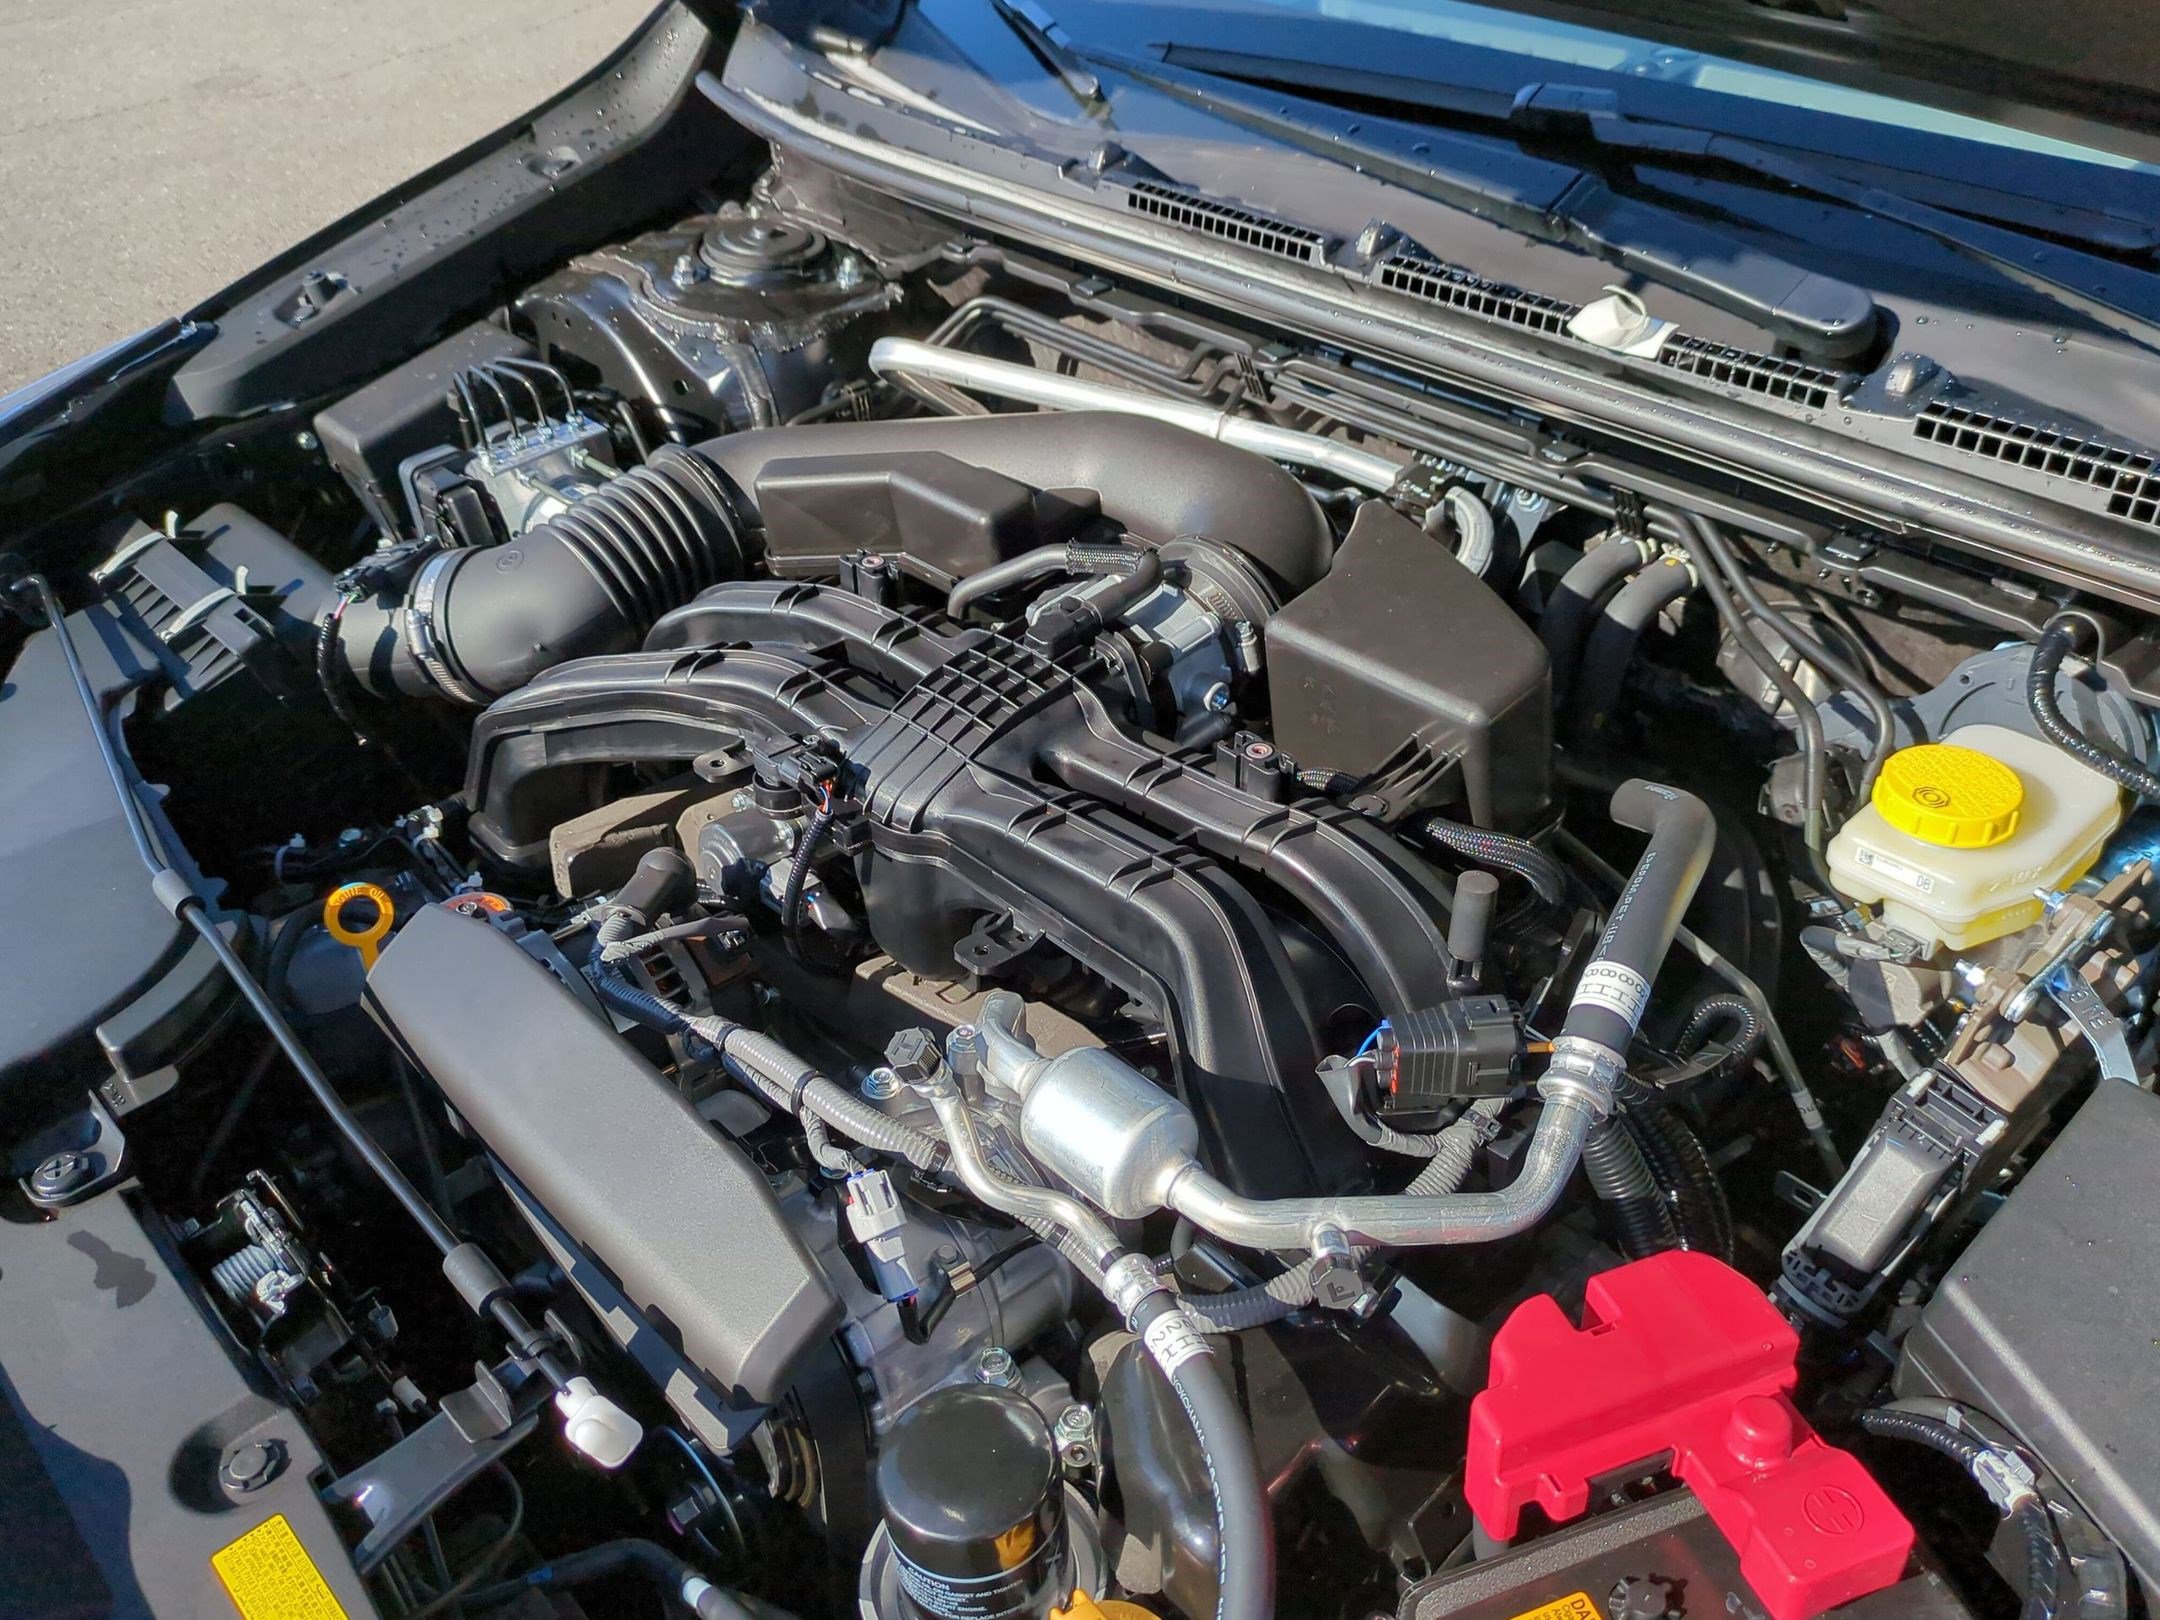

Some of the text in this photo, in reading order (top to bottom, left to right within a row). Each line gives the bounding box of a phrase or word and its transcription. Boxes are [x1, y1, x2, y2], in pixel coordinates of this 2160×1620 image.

[1172, 1374, 1205, 1448] YOKOHAMA
[908, 1566, 950, 1590] CAUTION
[1570, 1599, 1597, 1620] DA
